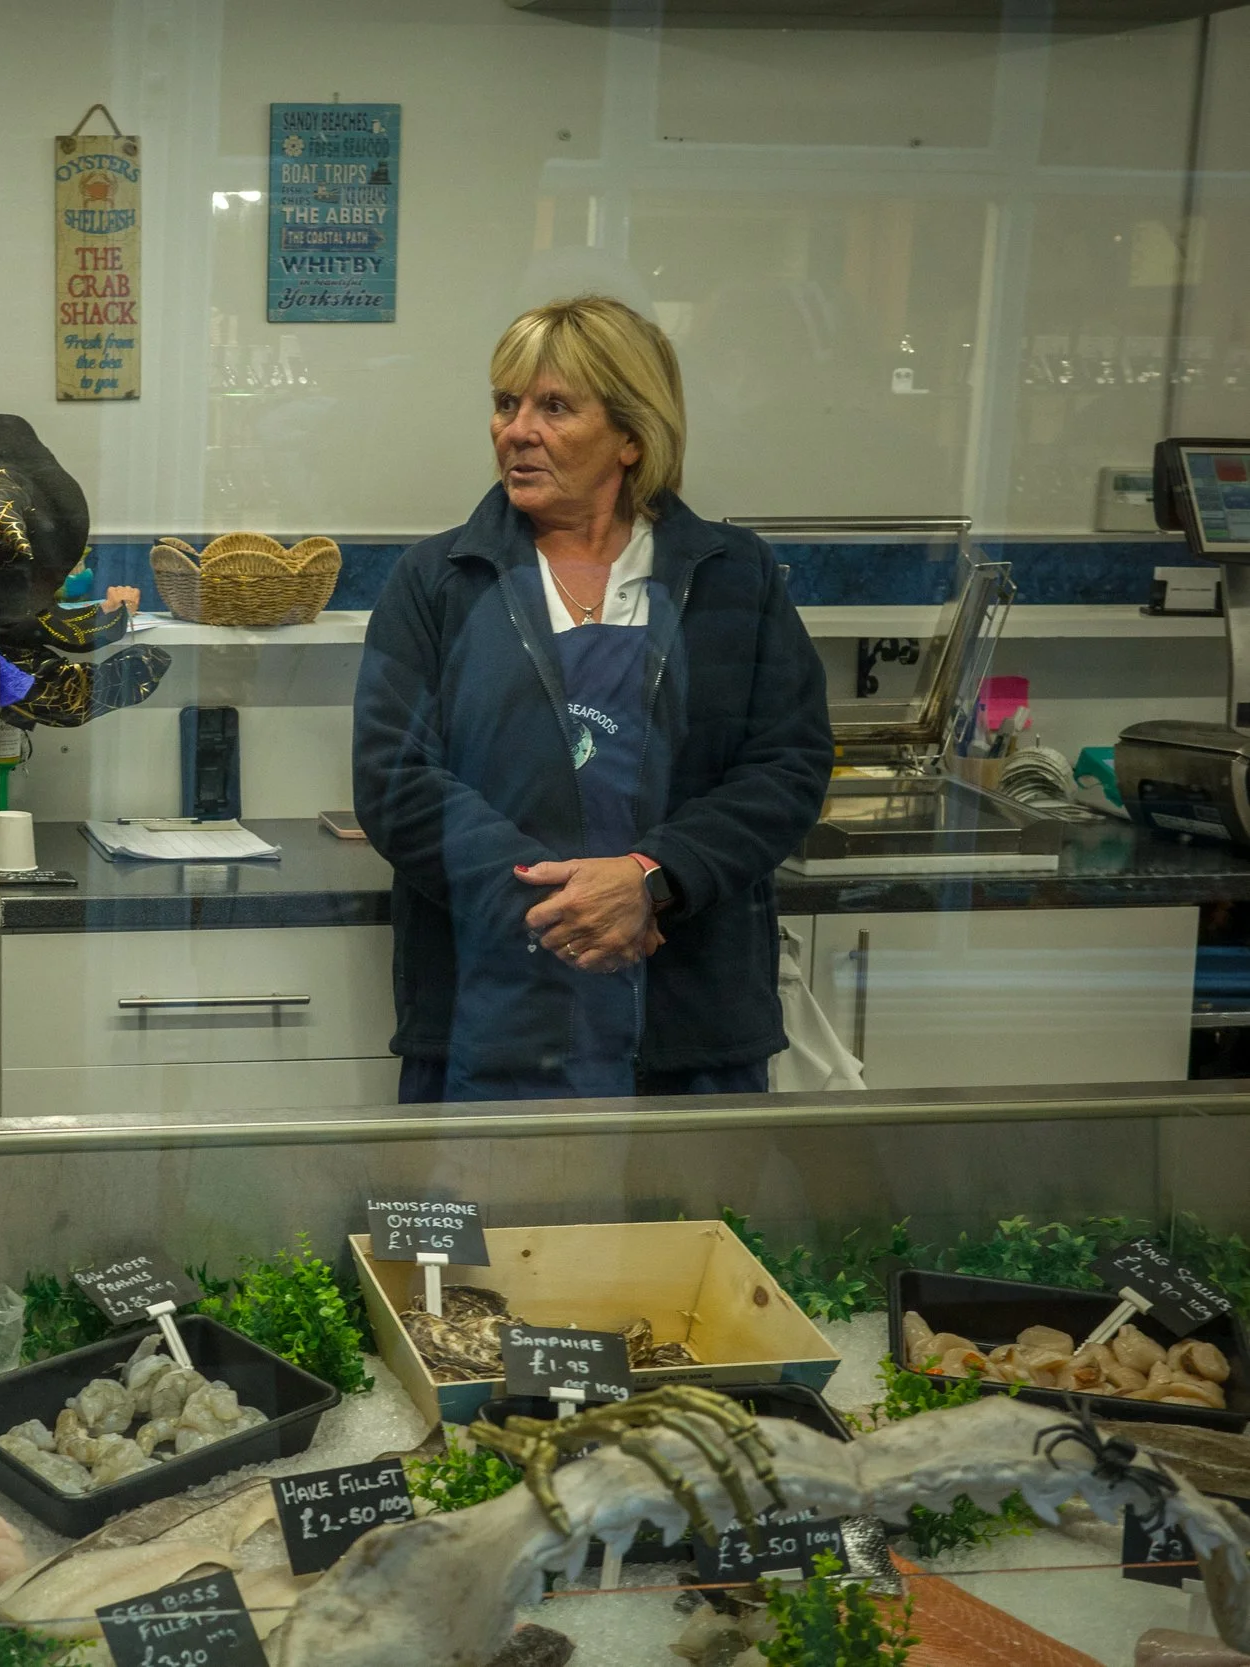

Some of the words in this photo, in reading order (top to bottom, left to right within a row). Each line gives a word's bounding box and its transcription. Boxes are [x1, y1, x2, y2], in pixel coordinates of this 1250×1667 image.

[282, 112, 318, 132] SANDY
[321, 112, 368, 132] BEACHES
[54, 153, 141, 183] OYSTERS
[281, 163, 319, 184] BOAT
[324, 164, 367, 185] TRIPS
[63, 208, 136, 235] SHELLFISH
[282, 207, 319, 225] THE
[325, 207, 390, 225] ABBEY
[287, 231, 304, 244] THE
[306, 231, 343, 244] COASTAL
[346, 231, 369, 244] PATH
[75, 247, 123, 271] THE
[279, 256, 384, 275] WHITBY
[67, 274, 131, 298] CRAB
[278, 287, 385, 309] Yorkshire
[59, 301, 138, 326] SHACK
[64, 332, 102, 349] Fresh
[567, 703, 619, 735] SEAFOODS
[367, 1199, 477, 1216] LINDISFARNE
[387, 1214, 464, 1230] OYSTERS
[1130, 1239, 1170, 1266] KING
[106, 1256, 154, 1275] TIGER
[97, 1271, 152, 1294] PRAWNS
[510, 1329, 604, 1351] SAMPHIRE
[595, 1382, 629, 1402] 100g
[280, 1481, 333, 1505] HAKE
[339, 1469, 403, 1495] FILLET
[380, 1495, 413, 1516] 100g
